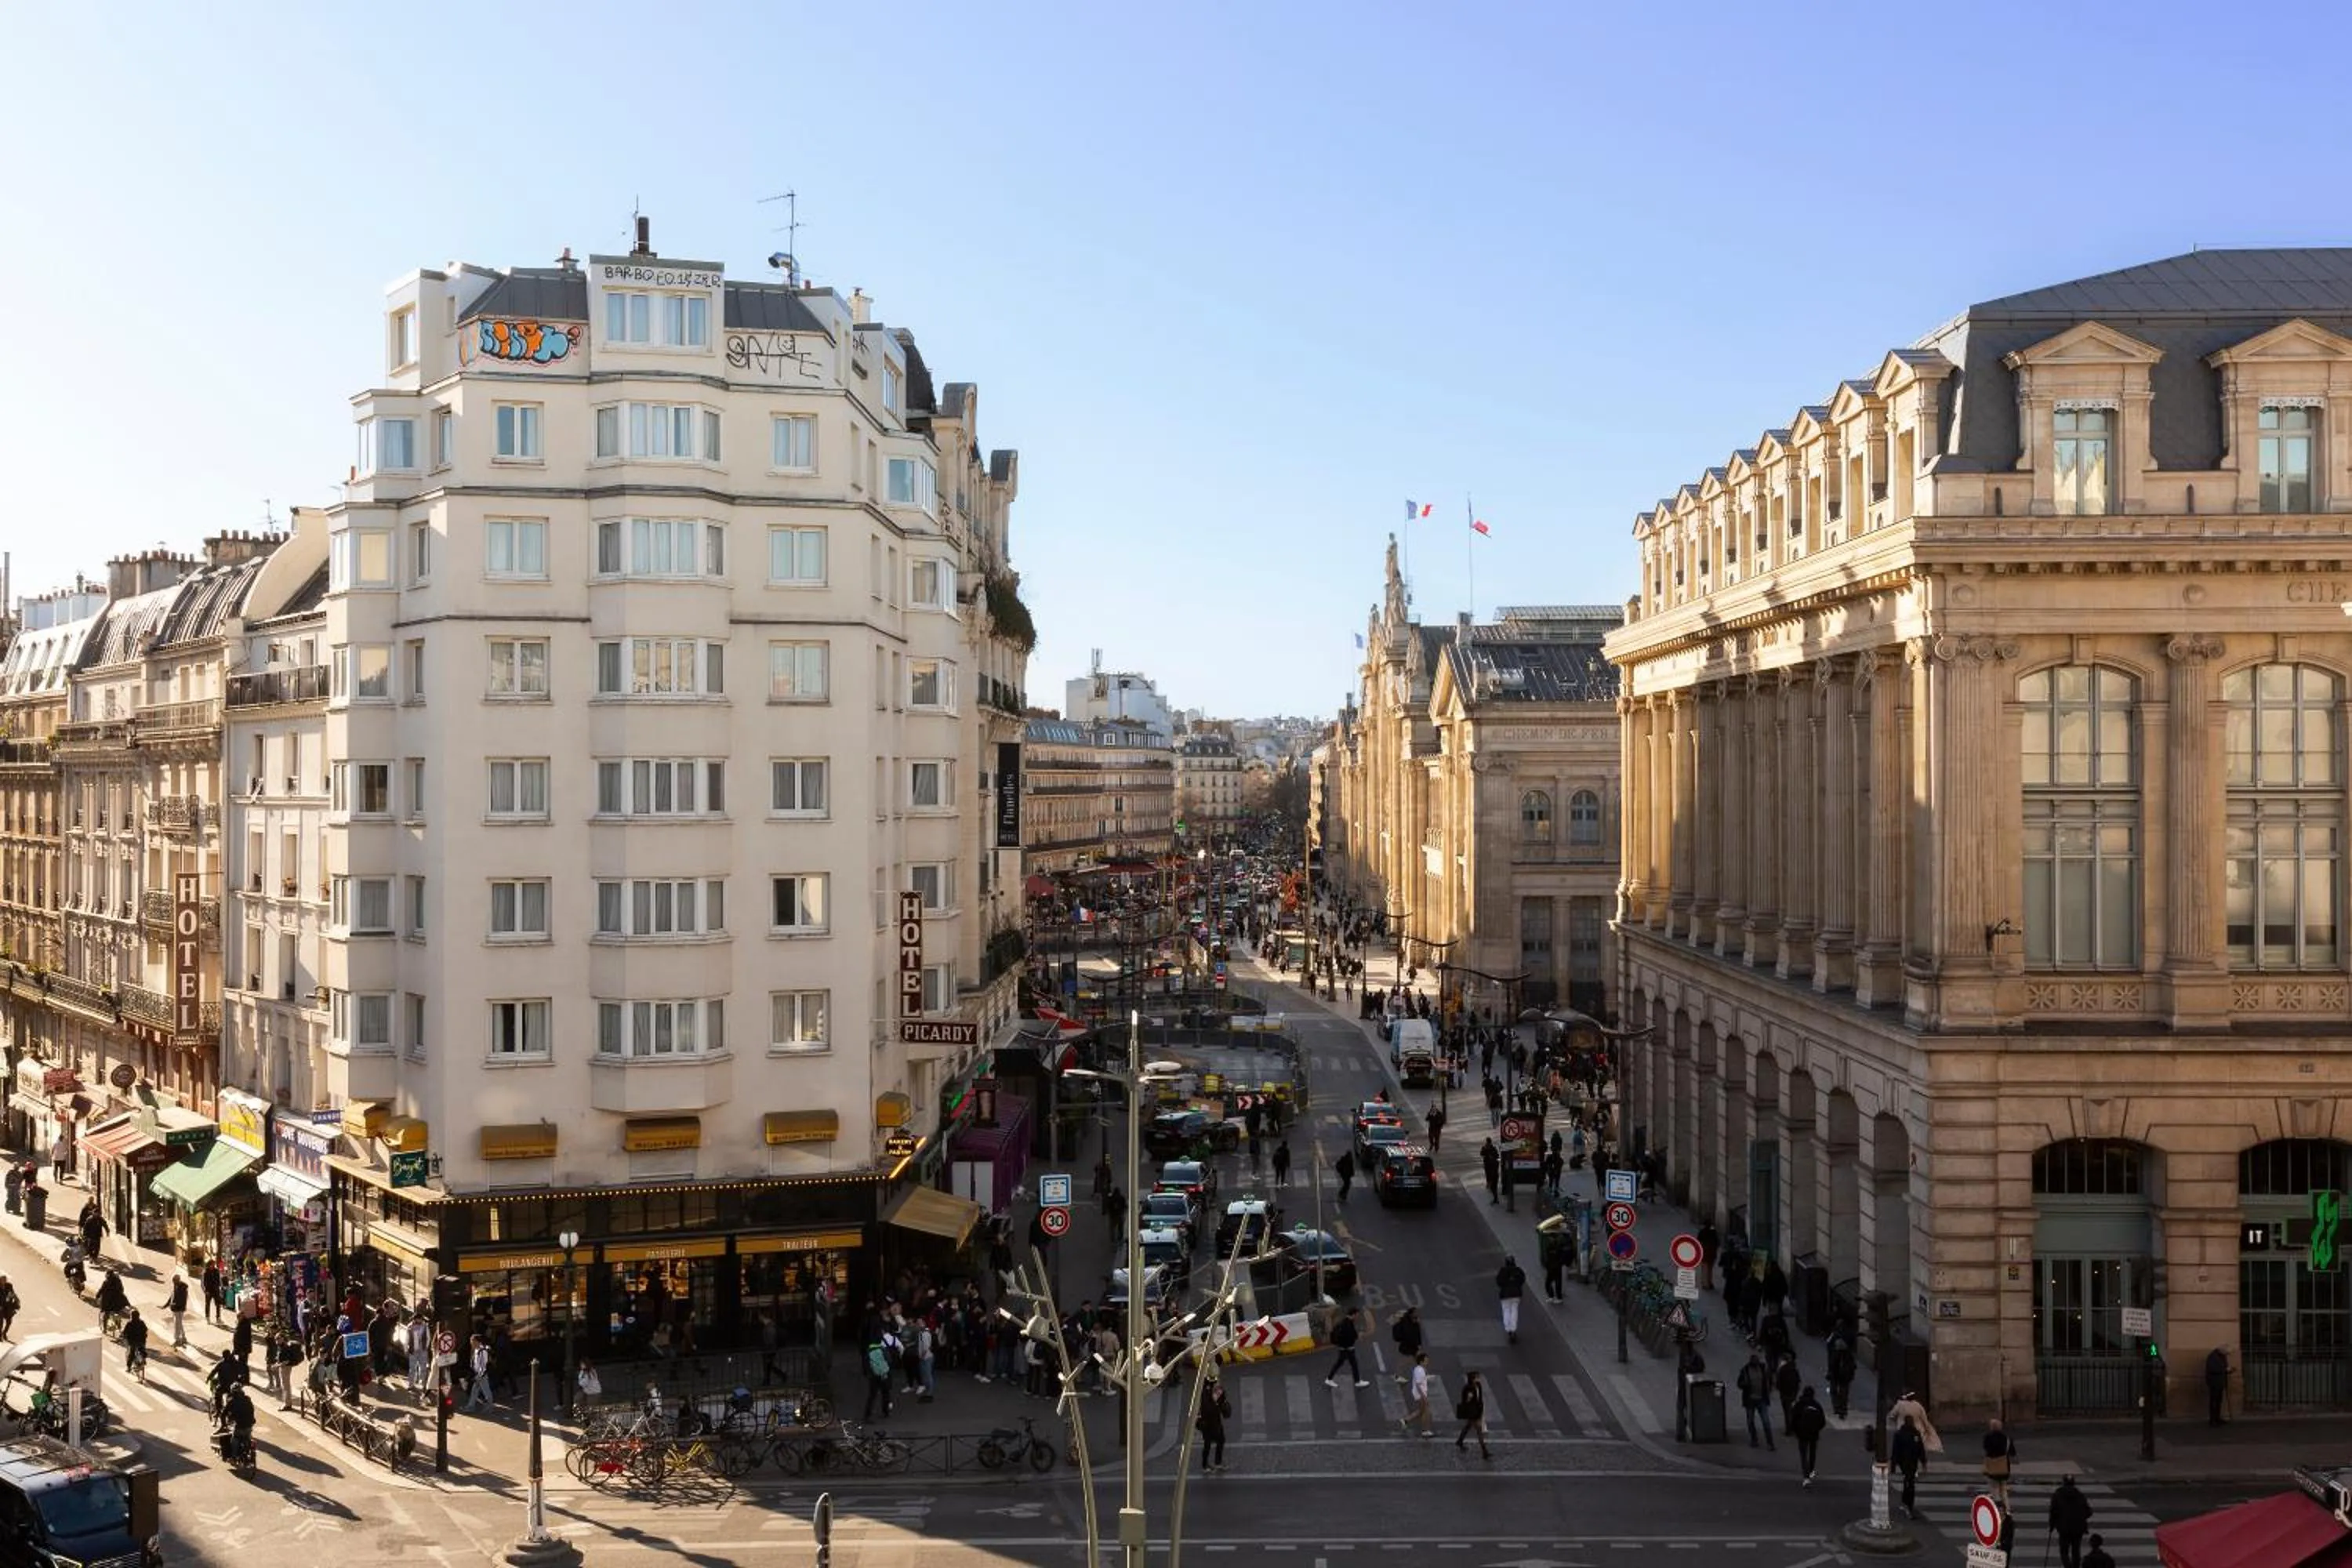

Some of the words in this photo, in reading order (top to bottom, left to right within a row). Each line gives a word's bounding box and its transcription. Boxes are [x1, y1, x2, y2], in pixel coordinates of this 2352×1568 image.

[1503, 728, 1554, 740] CHEMIN
[1559, 728, 1576, 739] DE
[178, 877, 198, 1030] HOTEL
[902, 898, 920, 1016] HOTEL
[904, 1025, 975, 1042] PICARDY
[1048, 1214, 1064, 1226] 30
[1613, 1210, 1629, 1223] 30
[782, 1240, 818, 1250] TRAITEUR
[499, 1256, 554, 1269] BOULANGERIE
[1365, 1283, 1461, 1309] BUS
